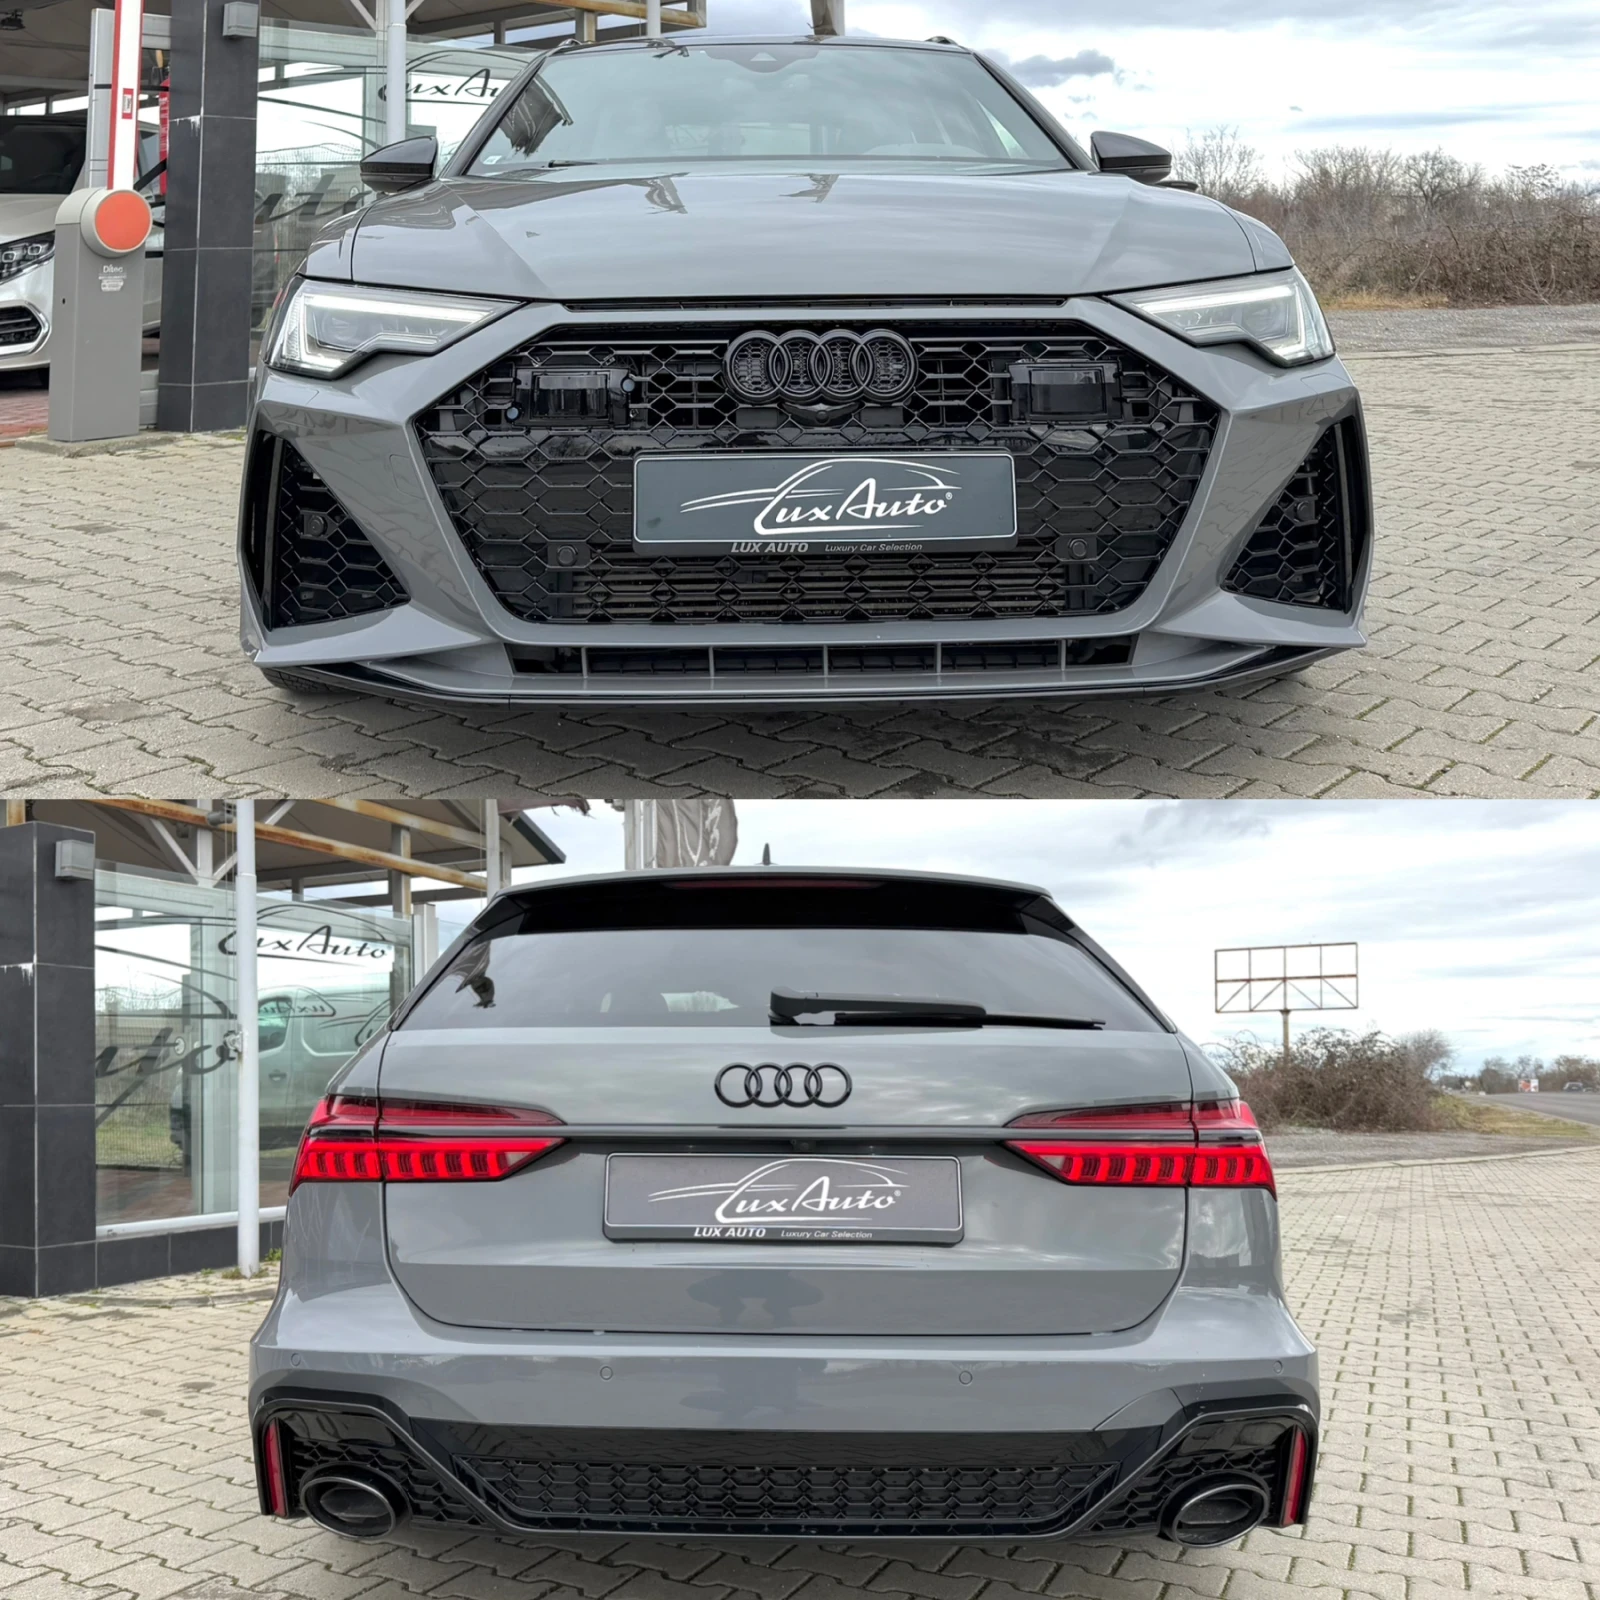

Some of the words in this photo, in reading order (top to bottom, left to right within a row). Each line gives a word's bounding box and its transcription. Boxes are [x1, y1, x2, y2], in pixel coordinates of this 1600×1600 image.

[731, 542, 763, 553] LUX
[764, 542, 809, 553] AUTO
[825, 544, 858, 552] Luxury
[859, 543, 876, 551] Car
[878, 542, 923, 551] Selection
[694, 1226, 721, 1237] LUX
[725, 1227, 766, 1237] AUTO
[780, 1230, 812, 1238] Luxury
[831, 1230, 872, 1238] Selection
